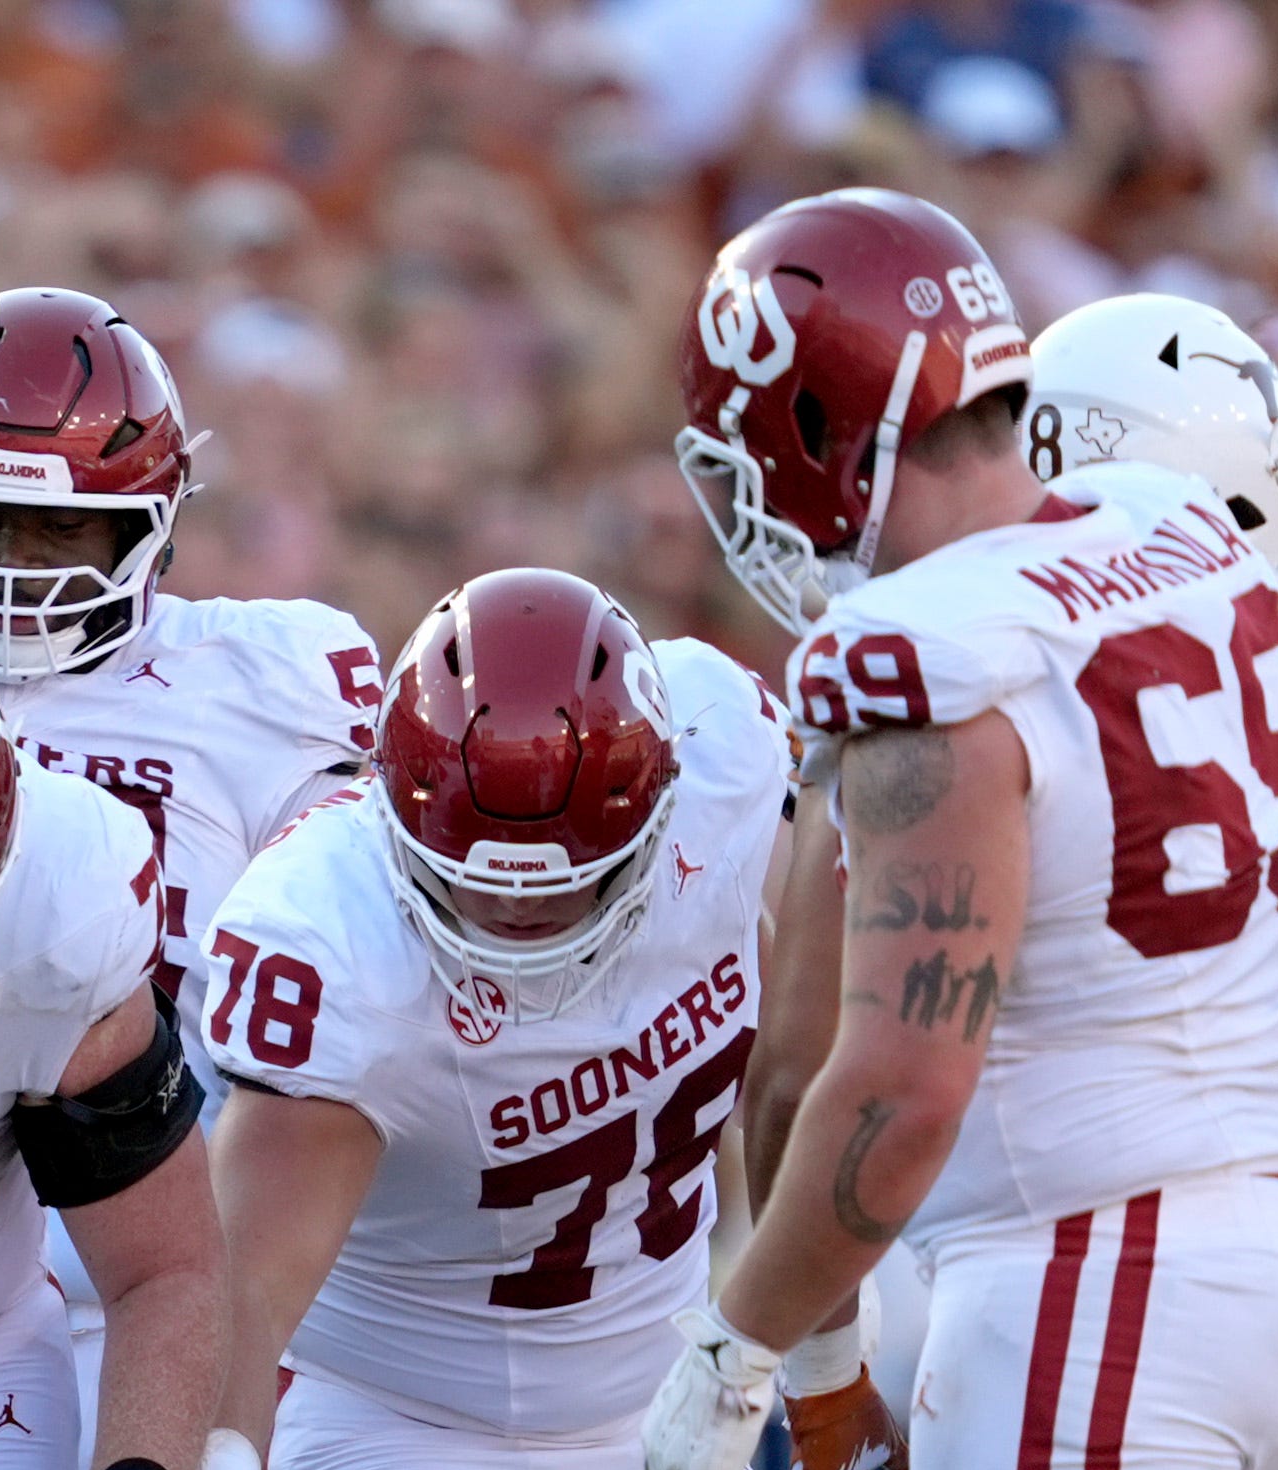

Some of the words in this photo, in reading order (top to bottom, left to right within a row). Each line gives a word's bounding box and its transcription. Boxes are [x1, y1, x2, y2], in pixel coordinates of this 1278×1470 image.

[946, 262, 1007, 322] 69
[798, 631, 932, 735] 69
[488, 858, 547, 872] OKLAHOMA
[209, 928, 323, 1070] 78
[490, 951, 748, 1149] SOONERS
